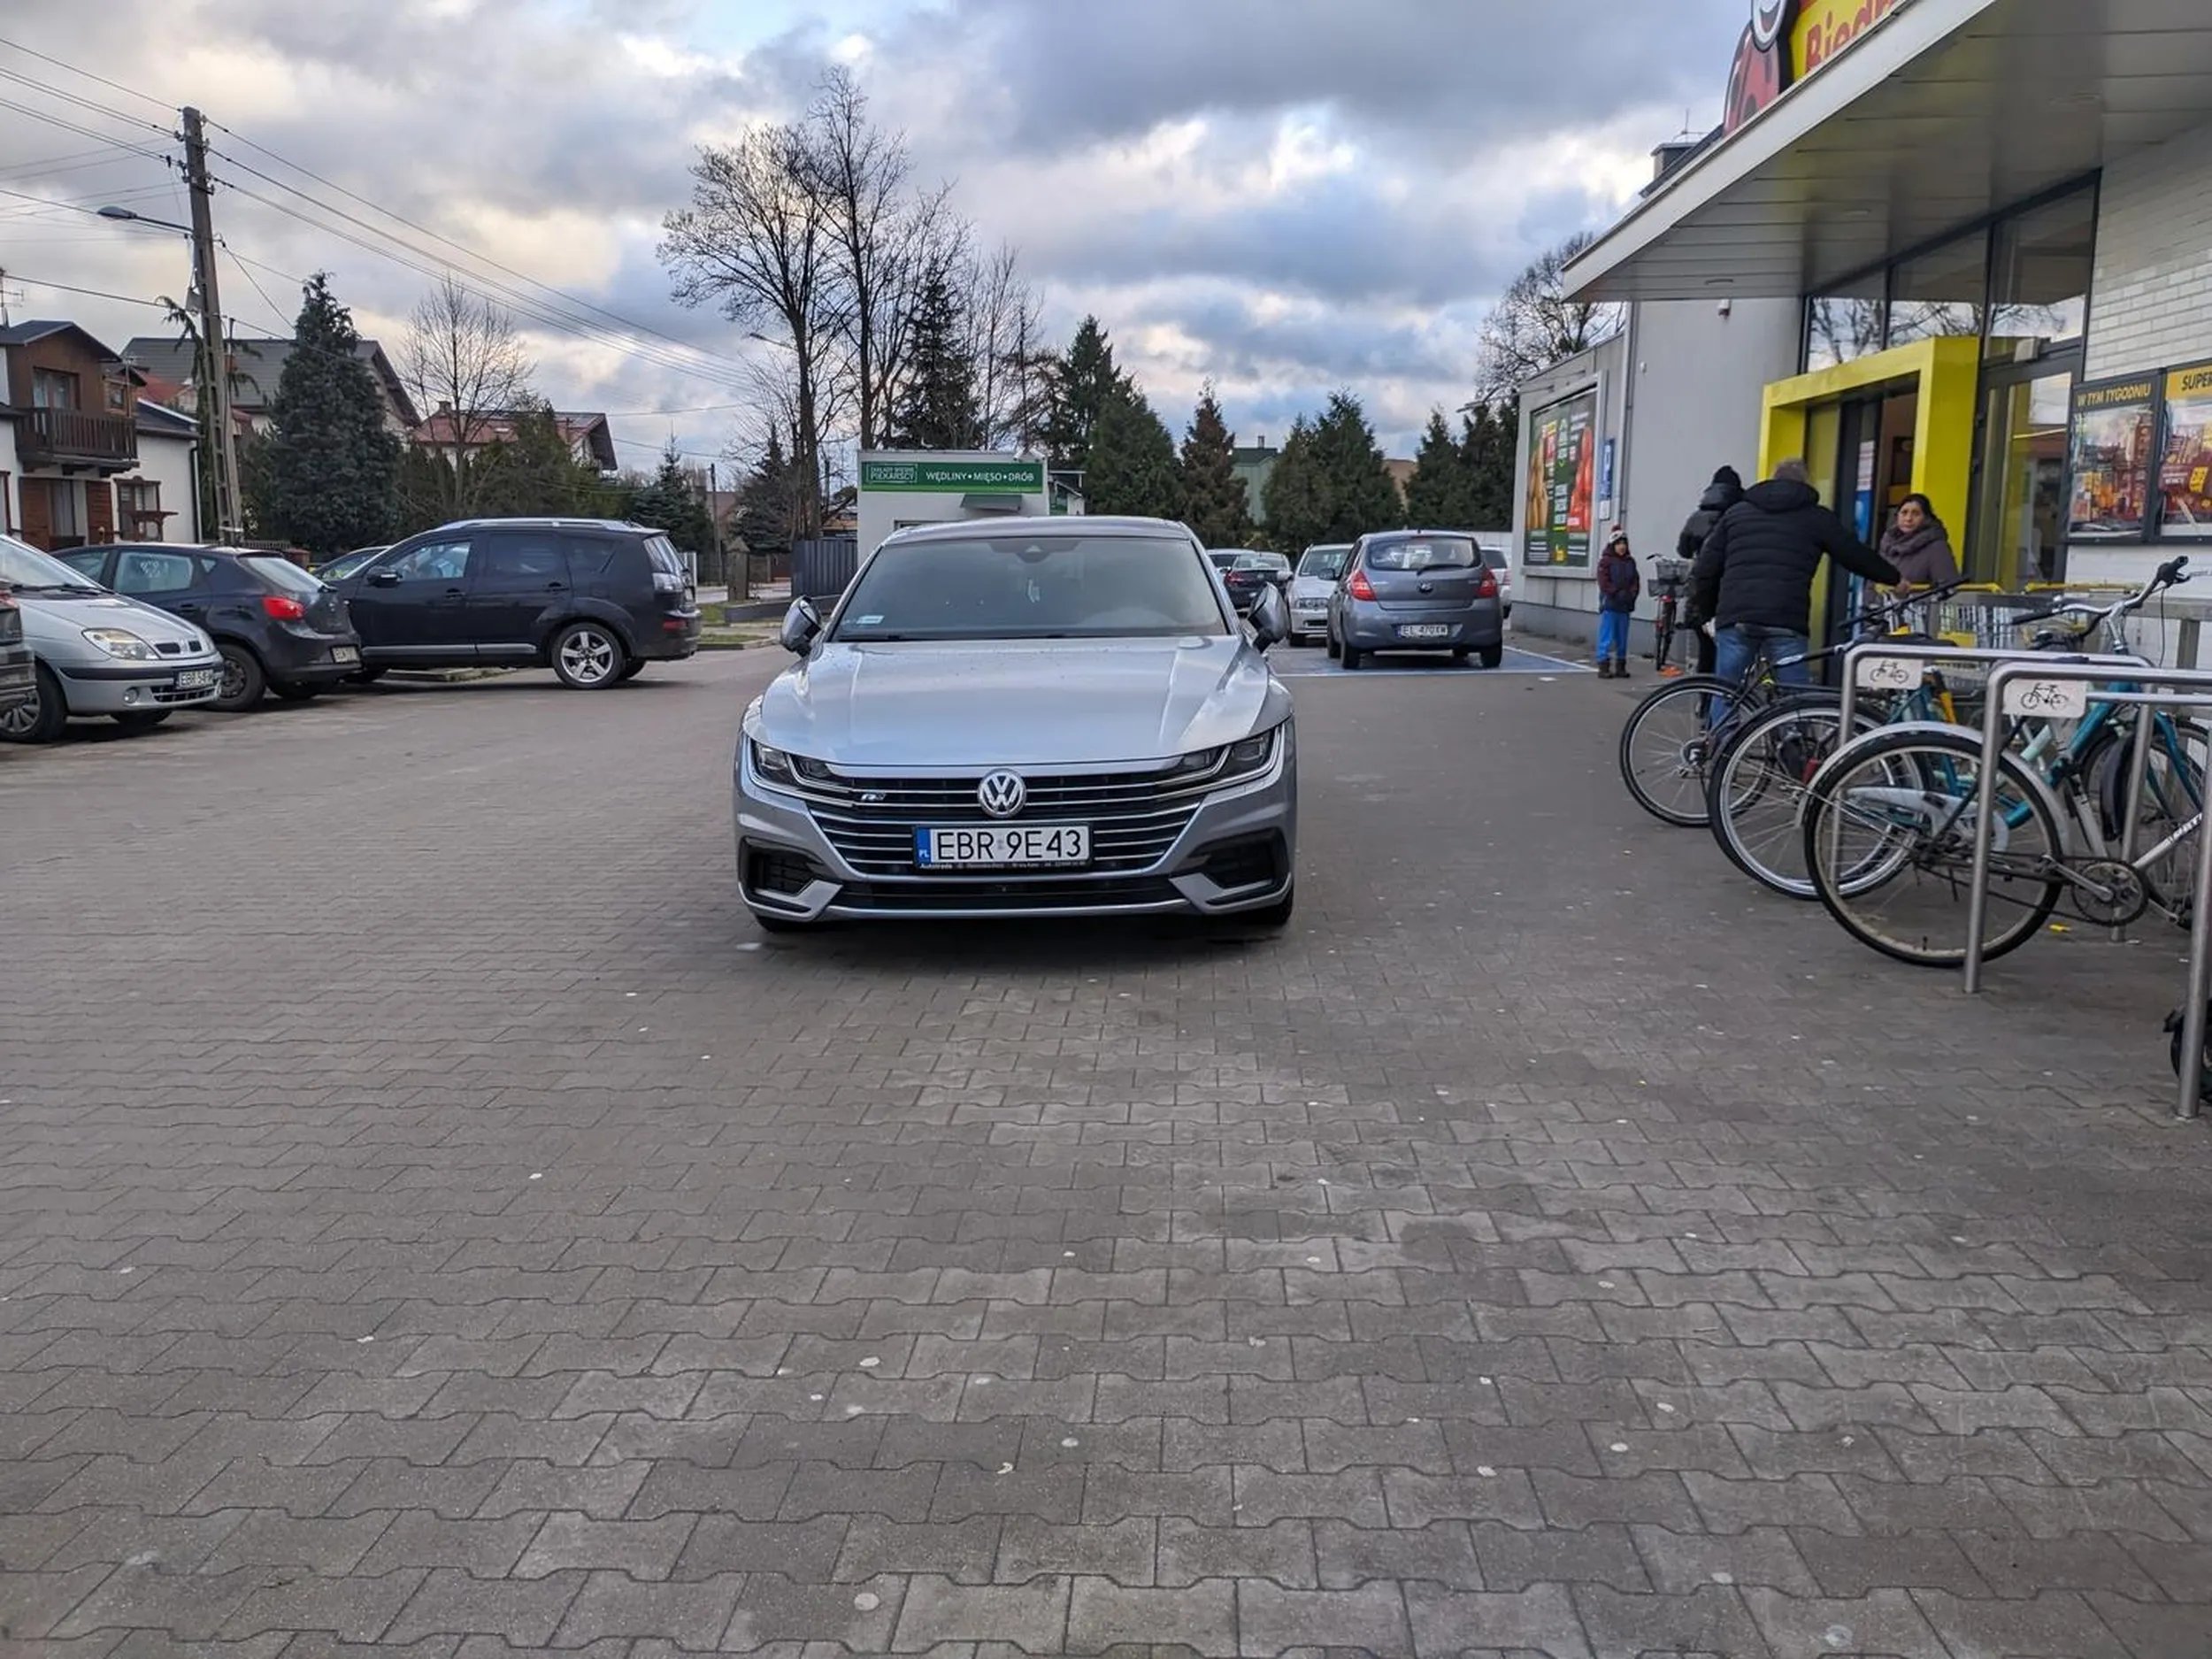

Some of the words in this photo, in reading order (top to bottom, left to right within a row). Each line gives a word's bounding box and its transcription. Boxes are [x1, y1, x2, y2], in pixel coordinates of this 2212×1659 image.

[1805, 0, 1894, 74] Bied
[2077, 393, 2087, 407] W
[2087, 389, 2105, 406] TYM
[2105, 382, 2151, 403] TYGODNIU
[926, 471, 967, 483] WĘDLINY
[972, 472, 1002, 484] MIĘSO
[1008, 471, 1034, 482] DRÓB
[937, 831, 994, 860] EBR
[1007, 830, 1080, 858] 9E43
